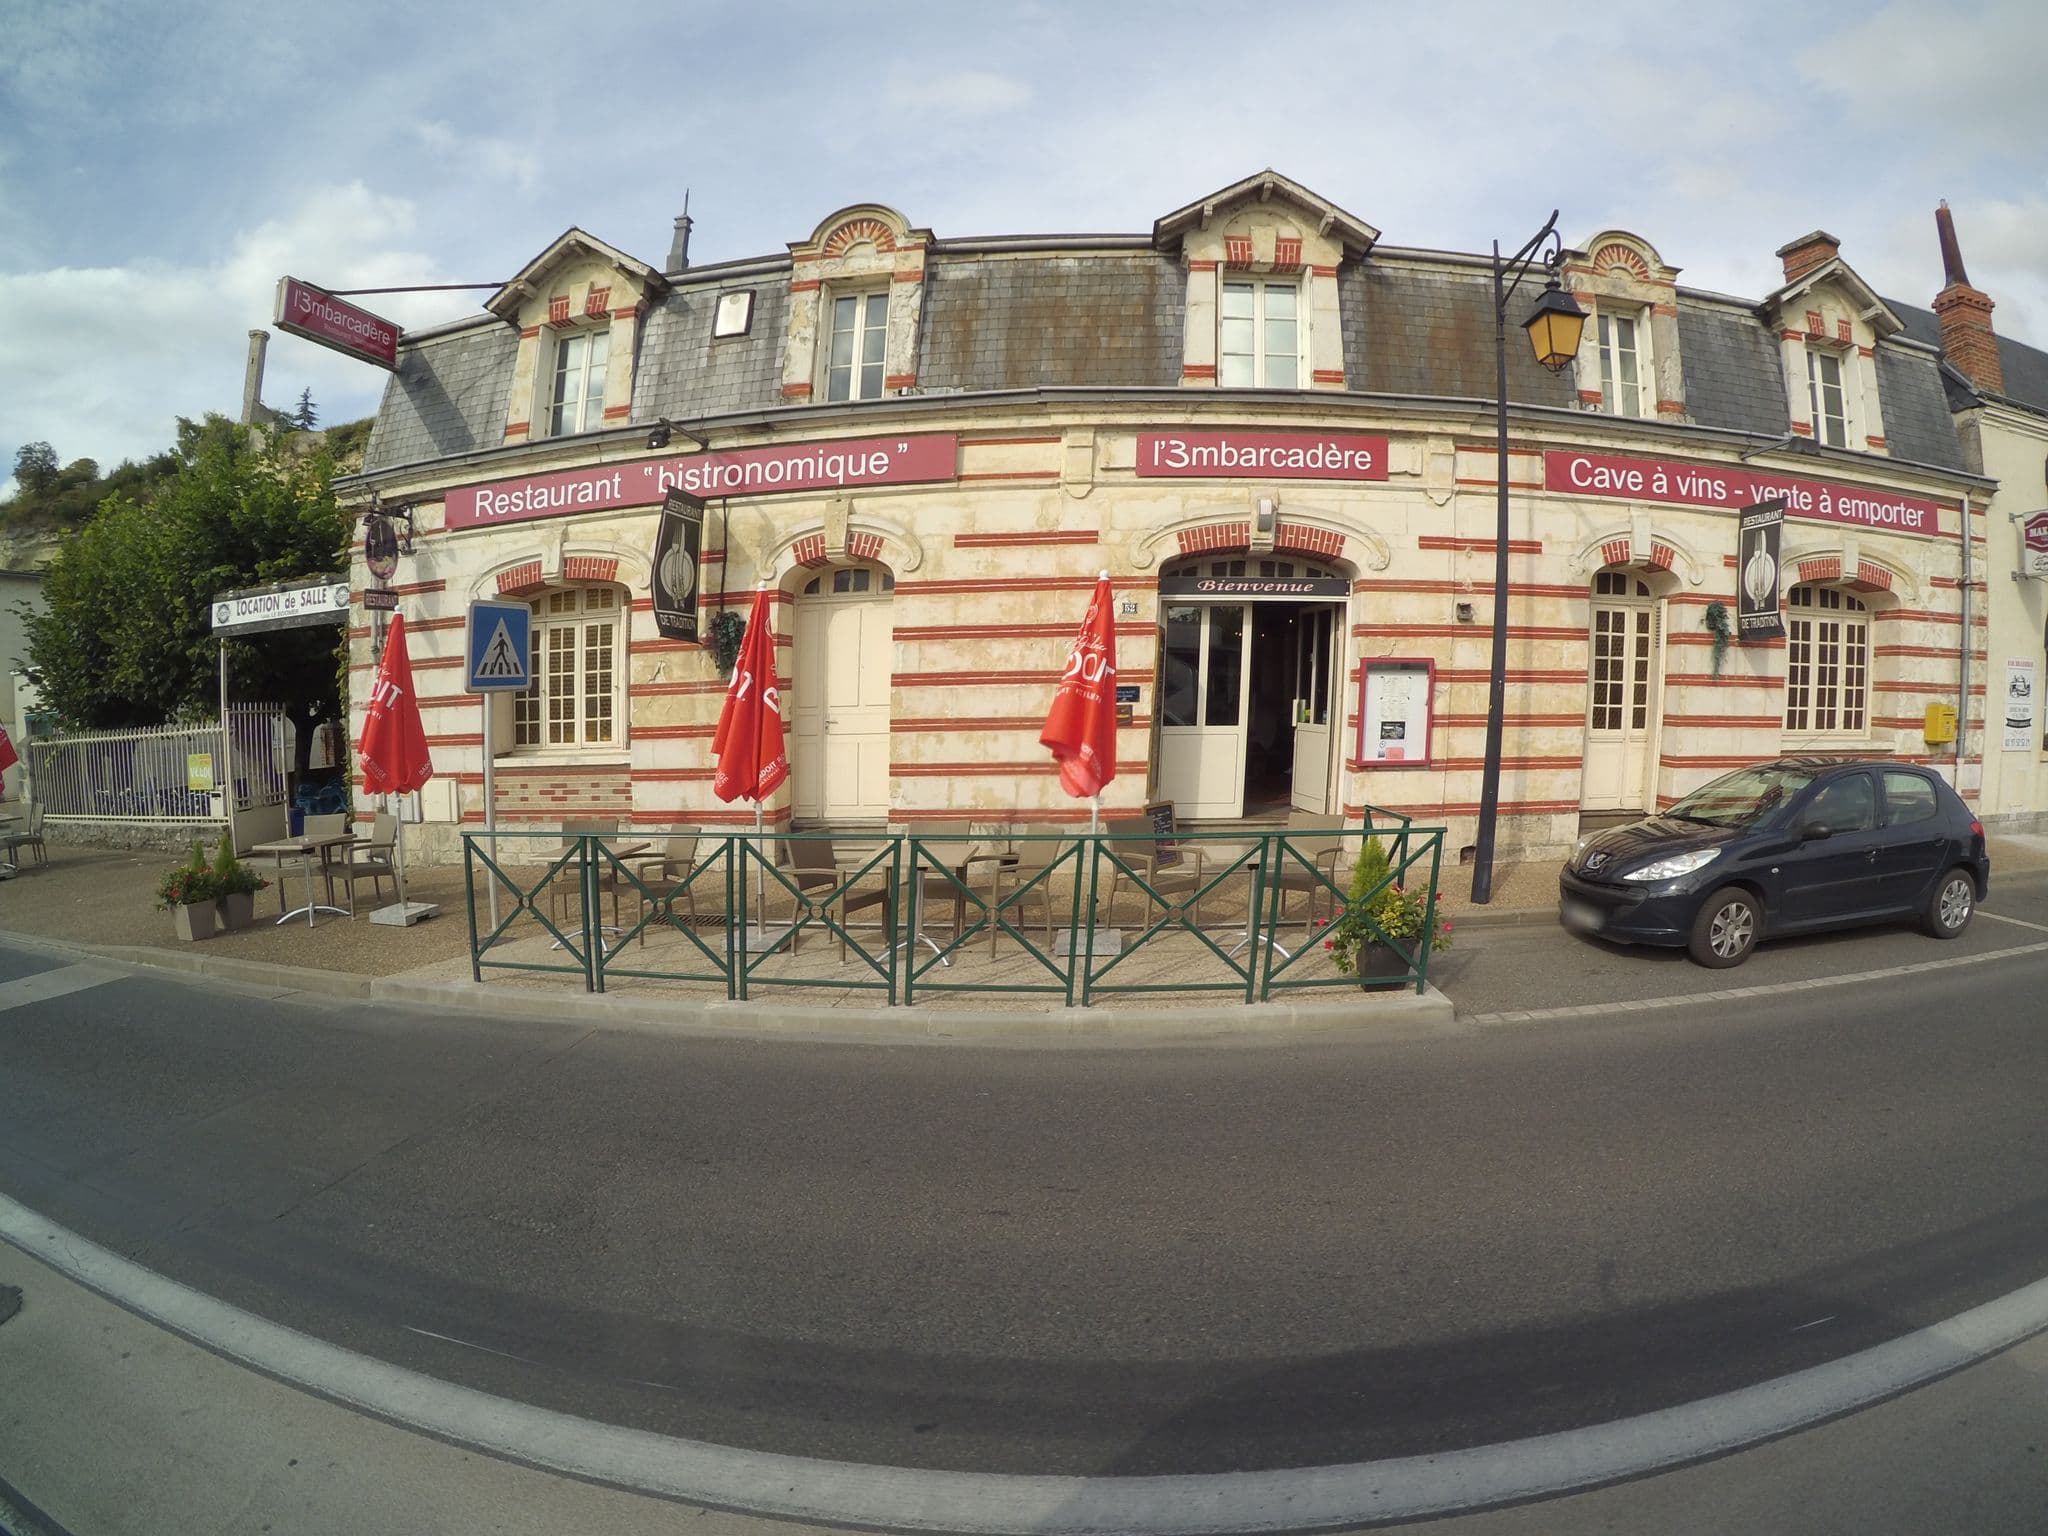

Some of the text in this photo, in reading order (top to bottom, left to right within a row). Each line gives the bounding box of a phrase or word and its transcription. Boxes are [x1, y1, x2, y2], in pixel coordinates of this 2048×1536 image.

[474, 471, 622, 518] Restaurant
[1570, 458, 1644, 492] Cave
[1652, 466, 1669, 495] à
[1676, 470, 1728, 501] vins
[1750, 484, 1813, 512] vente
[1819, 488, 1833, 514] à
[1838, 496, 1925, 528] emporter
[667, 499, 702, 519] RESTAURANT
[1743, 509, 1784, 527] RESTAURANT
[1197, 579, 1315, 593] Bienvenue
[236, 594, 280, 617] LOCATION
[285, 592, 297, 610] de
[301, 587, 328, 606] SALLE
[1124, 604, 1136, 613] 52
[660, 614, 696, 630] DE TRADITION
[1741, 616, 1779, 630] DE TRADITION
